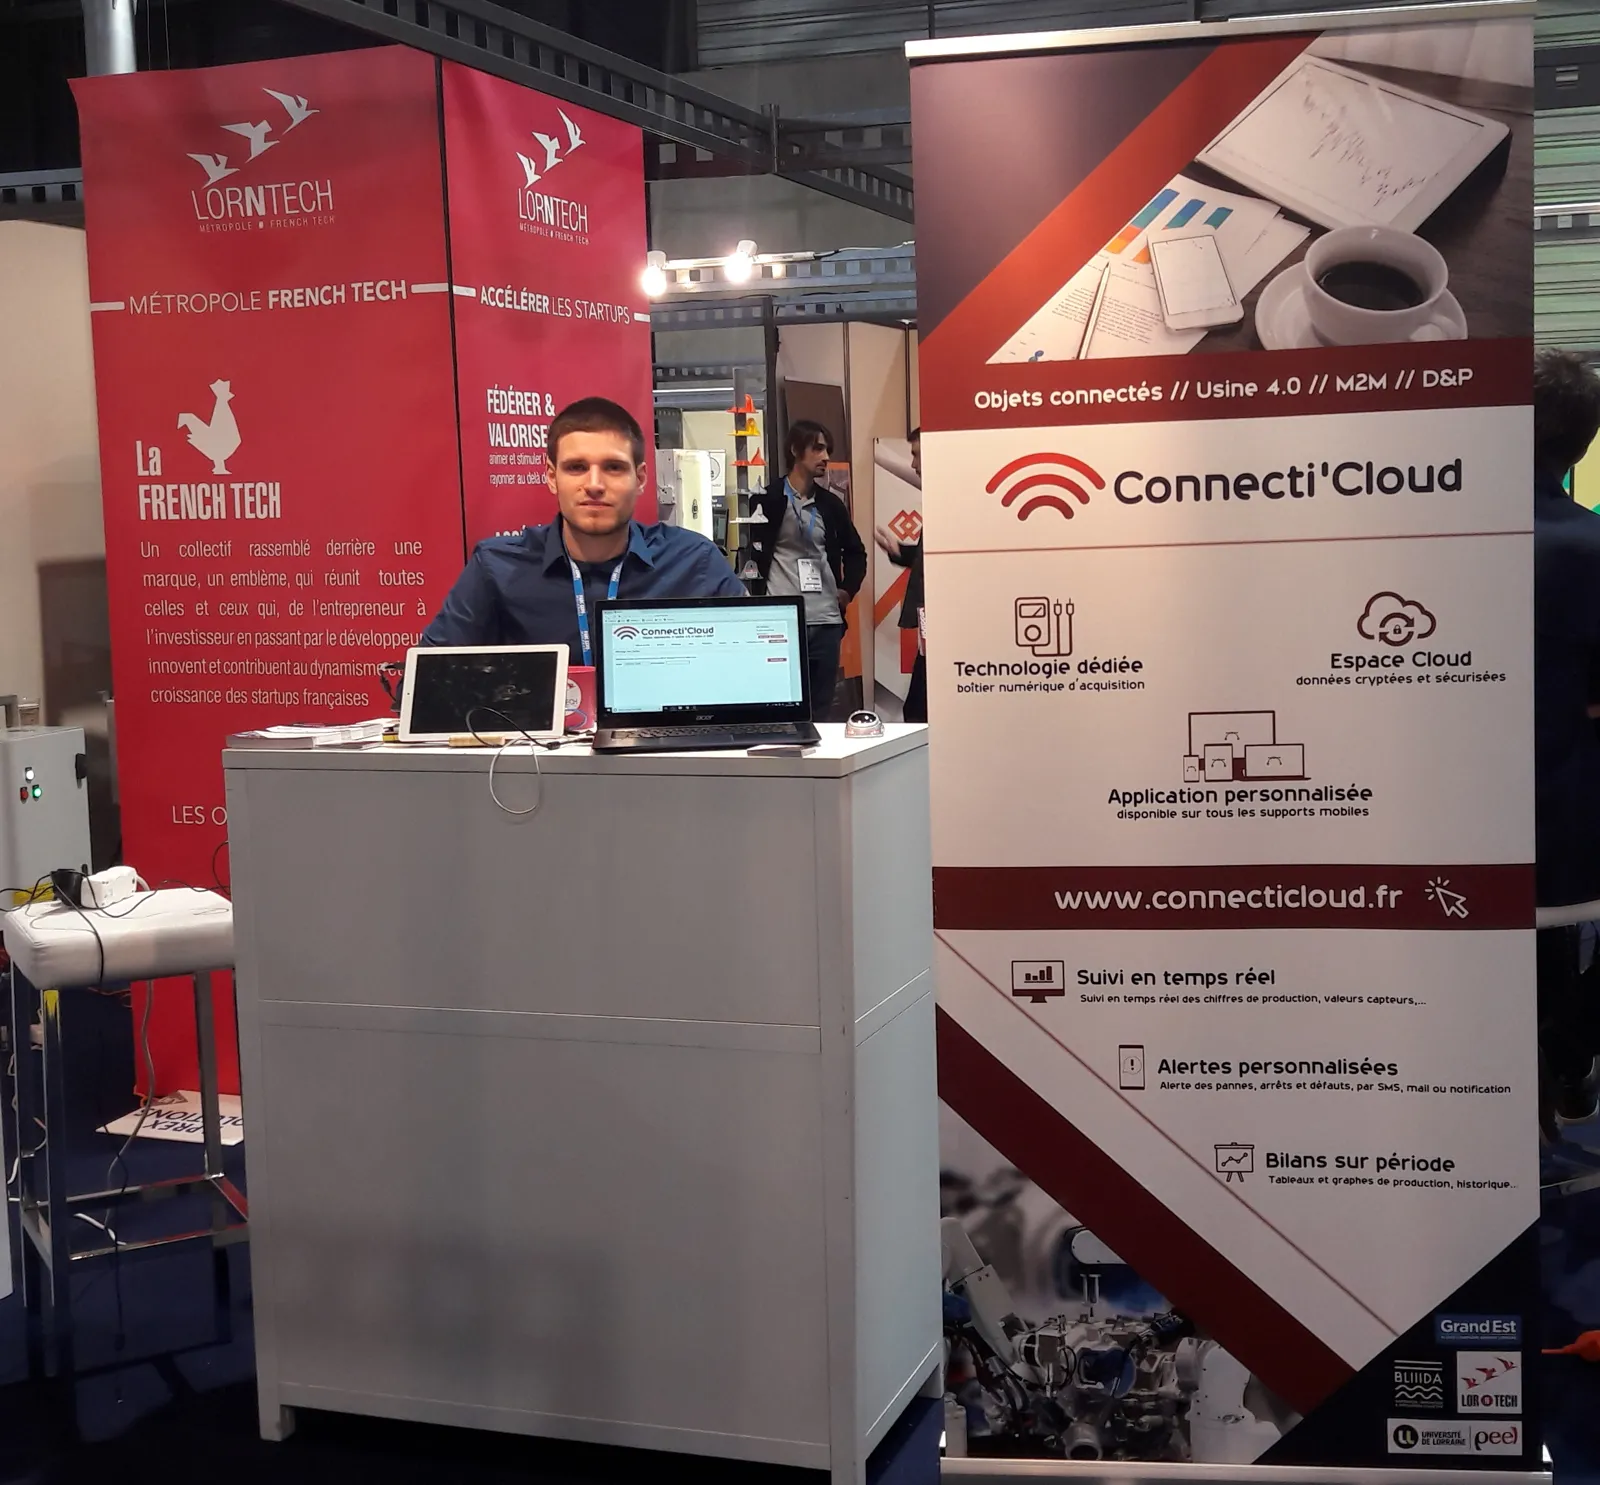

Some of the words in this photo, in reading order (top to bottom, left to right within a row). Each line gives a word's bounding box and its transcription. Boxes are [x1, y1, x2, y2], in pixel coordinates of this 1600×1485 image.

[199, 221, 253, 233] MÉTROPOLE
[270, 217, 308, 228] FRENCH
[312, 215, 335, 225] TECH
[554, 232, 574, 243] FRENCH
[575, 234, 589, 245] TECH
[129, 290, 261, 315] MÉTROPOLE
[268, 284, 346, 310] FRENCH
[351, 279, 408, 302] TECH
[480, 284, 549, 314] ACCÉLÉRER
[552, 296, 572, 317] LES
[575, 299, 630, 324] STARTUPS
[487, 383, 541, 416] FÉDÉRER
[544, 393, 556, 416] &
[974, 390, 1042, 412] Objets
[1050, 381, 1163, 406] connectés
[1170, 380, 1190, 401] //
[1196, 379, 1258, 399] Usine
[1266, 377, 1301, 395] 4.0
[1308, 373, 1329, 394] //
[1336, 373, 1387, 392] M2M
[1395, 369, 1415, 390] //
[1423, 368, 1473, 388] D&P
[488, 422, 549, 448] VALORISE
[135, 440, 162, 476] La
[510, 452, 517, 465] et
[517, 452, 541, 465] stimuler
[490, 473, 515, 487] rayonner
[517, 474, 526, 485] au
[527, 471, 541, 485] delà
[1114, 458, 1462, 504] Connecti'Cloud
[138, 482, 227, 521] FRENCH
[230, 481, 281, 520] TECH
[140, 541, 160, 558] Un
[179, 540, 232, 557] collectif
[249, 539, 310, 557] rassemblé
[326, 538, 375, 556] derrière
[394, 541, 422, 555] une
[143, 573, 200, 590] marque,
[207, 573, 224, 587] un
[230, 569, 290, 588] emblème,
[295, 569, 313, 590] qui
[324, 568, 360, 586] réunit
[378, 569, 424, 586] toutes
[145, 600, 184, 616] celles
[195, 601, 209, 616] et
[219, 602, 248, 616] ceux
[257, 600, 280, 618] qui,
[288, 599, 304, 616] de
[312, 599, 405, 619] l'entrepreneur
[417, 597, 426, 616] à
[146, 628, 234, 646] l'investisseur
[237, 631, 252, 645] en
[255, 631, 301, 650] passant
[303, 631, 323, 650] par
[326, 628, 337, 645] le
[641, 626, 715, 636] Connecti'Cloud
[148, 658, 206, 674] innovent
[208, 659, 221, 674] et
[223, 658, 290, 675] contribuent
[293, 661, 308, 675] au
[953, 658, 1071, 679] Technologie
[1077, 655, 1143, 674] dédiée
[1331, 653, 1405, 672] Espace
[1412, 650, 1472, 667] Cloud
[957, 681, 995, 693] boîtier
[999, 680, 1065, 693] numérique
[1068, 678, 1145, 692] d'acquisition
[1296, 673, 1351, 686] données
[1355, 672, 1413, 686] cryptées
[1417, 674, 1431, 684] et
[1435, 670, 1506, 683] sécurisées
[151, 687, 222, 703] croissance
[225, 687, 248, 703] des
[251, 688, 299, 707] startups
[302, 689, 369, 709] françaises
[1108, 787, 1218, 807] Application
[1224, 783, 1373, 805] personnalisée
[172, 805, 205, 825] LES
[1117, 808, 1177, 820] disponible
[1181, 809, 1201, 819] sur
[1206, 807, 1234, 818] tous
[1238, 806, 1256, 817] les
[1260, 807, 1315, 819] supports
[1319, 806, 1369, 817] mobiles
[1054, 884, 1403, 909] www.connecticloud.fr
[1077, 969, 1124, 985] Suivi
[1131, 972, 1156, 985] en
[1163, 970, 1228, 989] temps
[1235, 967, 1275, 985] réel
[1080, 994, 1104, 1003] Suivi
[1107, 995, 1120, 1003] en
[1123, 994, 1156, 1004] temps
[1159, 993, 1179, 1003] réel
[1182, 994, 1200, 1003] des
[1203, 993, 1244, 1003] chiffres
[1246, 994, 1259, 1003] de
[1262, 994, 1321, 1004] production,
[1324, 994, 1364, 1003] valeurs
[1157, 1058, 1232, 1074] Alertes
[1239, 1056, 1398, 1078] personnalisées
[1160, 1081, 1191, 1090] Alerte
[1194, 1081, 1213, 1090] des
[1216, 1082, 1257, 1091] pannes,
[1260, 1080, 1292, 1090] arrêts
[1296, 1081, 1307, 1090] et
[1309, 1080, 1354, 1091] défauts,
[1357, 1083, 1374, 1092] par
[1377, 1083, 1404, 1093] SMS,
[1406, 1084, 1430, 1093] mail
[1450, 1085, 1511, 1094] notification
[143, 1119, 207, 1133] PREX
[1266, 1152, 1328, 1168] Bilans
[1334, 1155, 1369, 1169] sur
[1376, 1152, 1455, 1173] période
[1268, 1175, 1314, 1184] Tableaux
[1317, 1176, 1329, 1184] et
[1332, 1176, 1374, 1186] graphes
[1376, 1177, 1390, 1185] de
[1393, 1179, 1453, 1190] production,
[1440, 1319, 1490, 1333] Grand
[1492, 1320, 1517, 1333] Est
[1394, 1371, 1443, 1384] BLIIIDA
[1421, 1430, 1461, 1438] UNIVERSITÉ
[1433, 1438, 1466, 1446] LORRAINE
